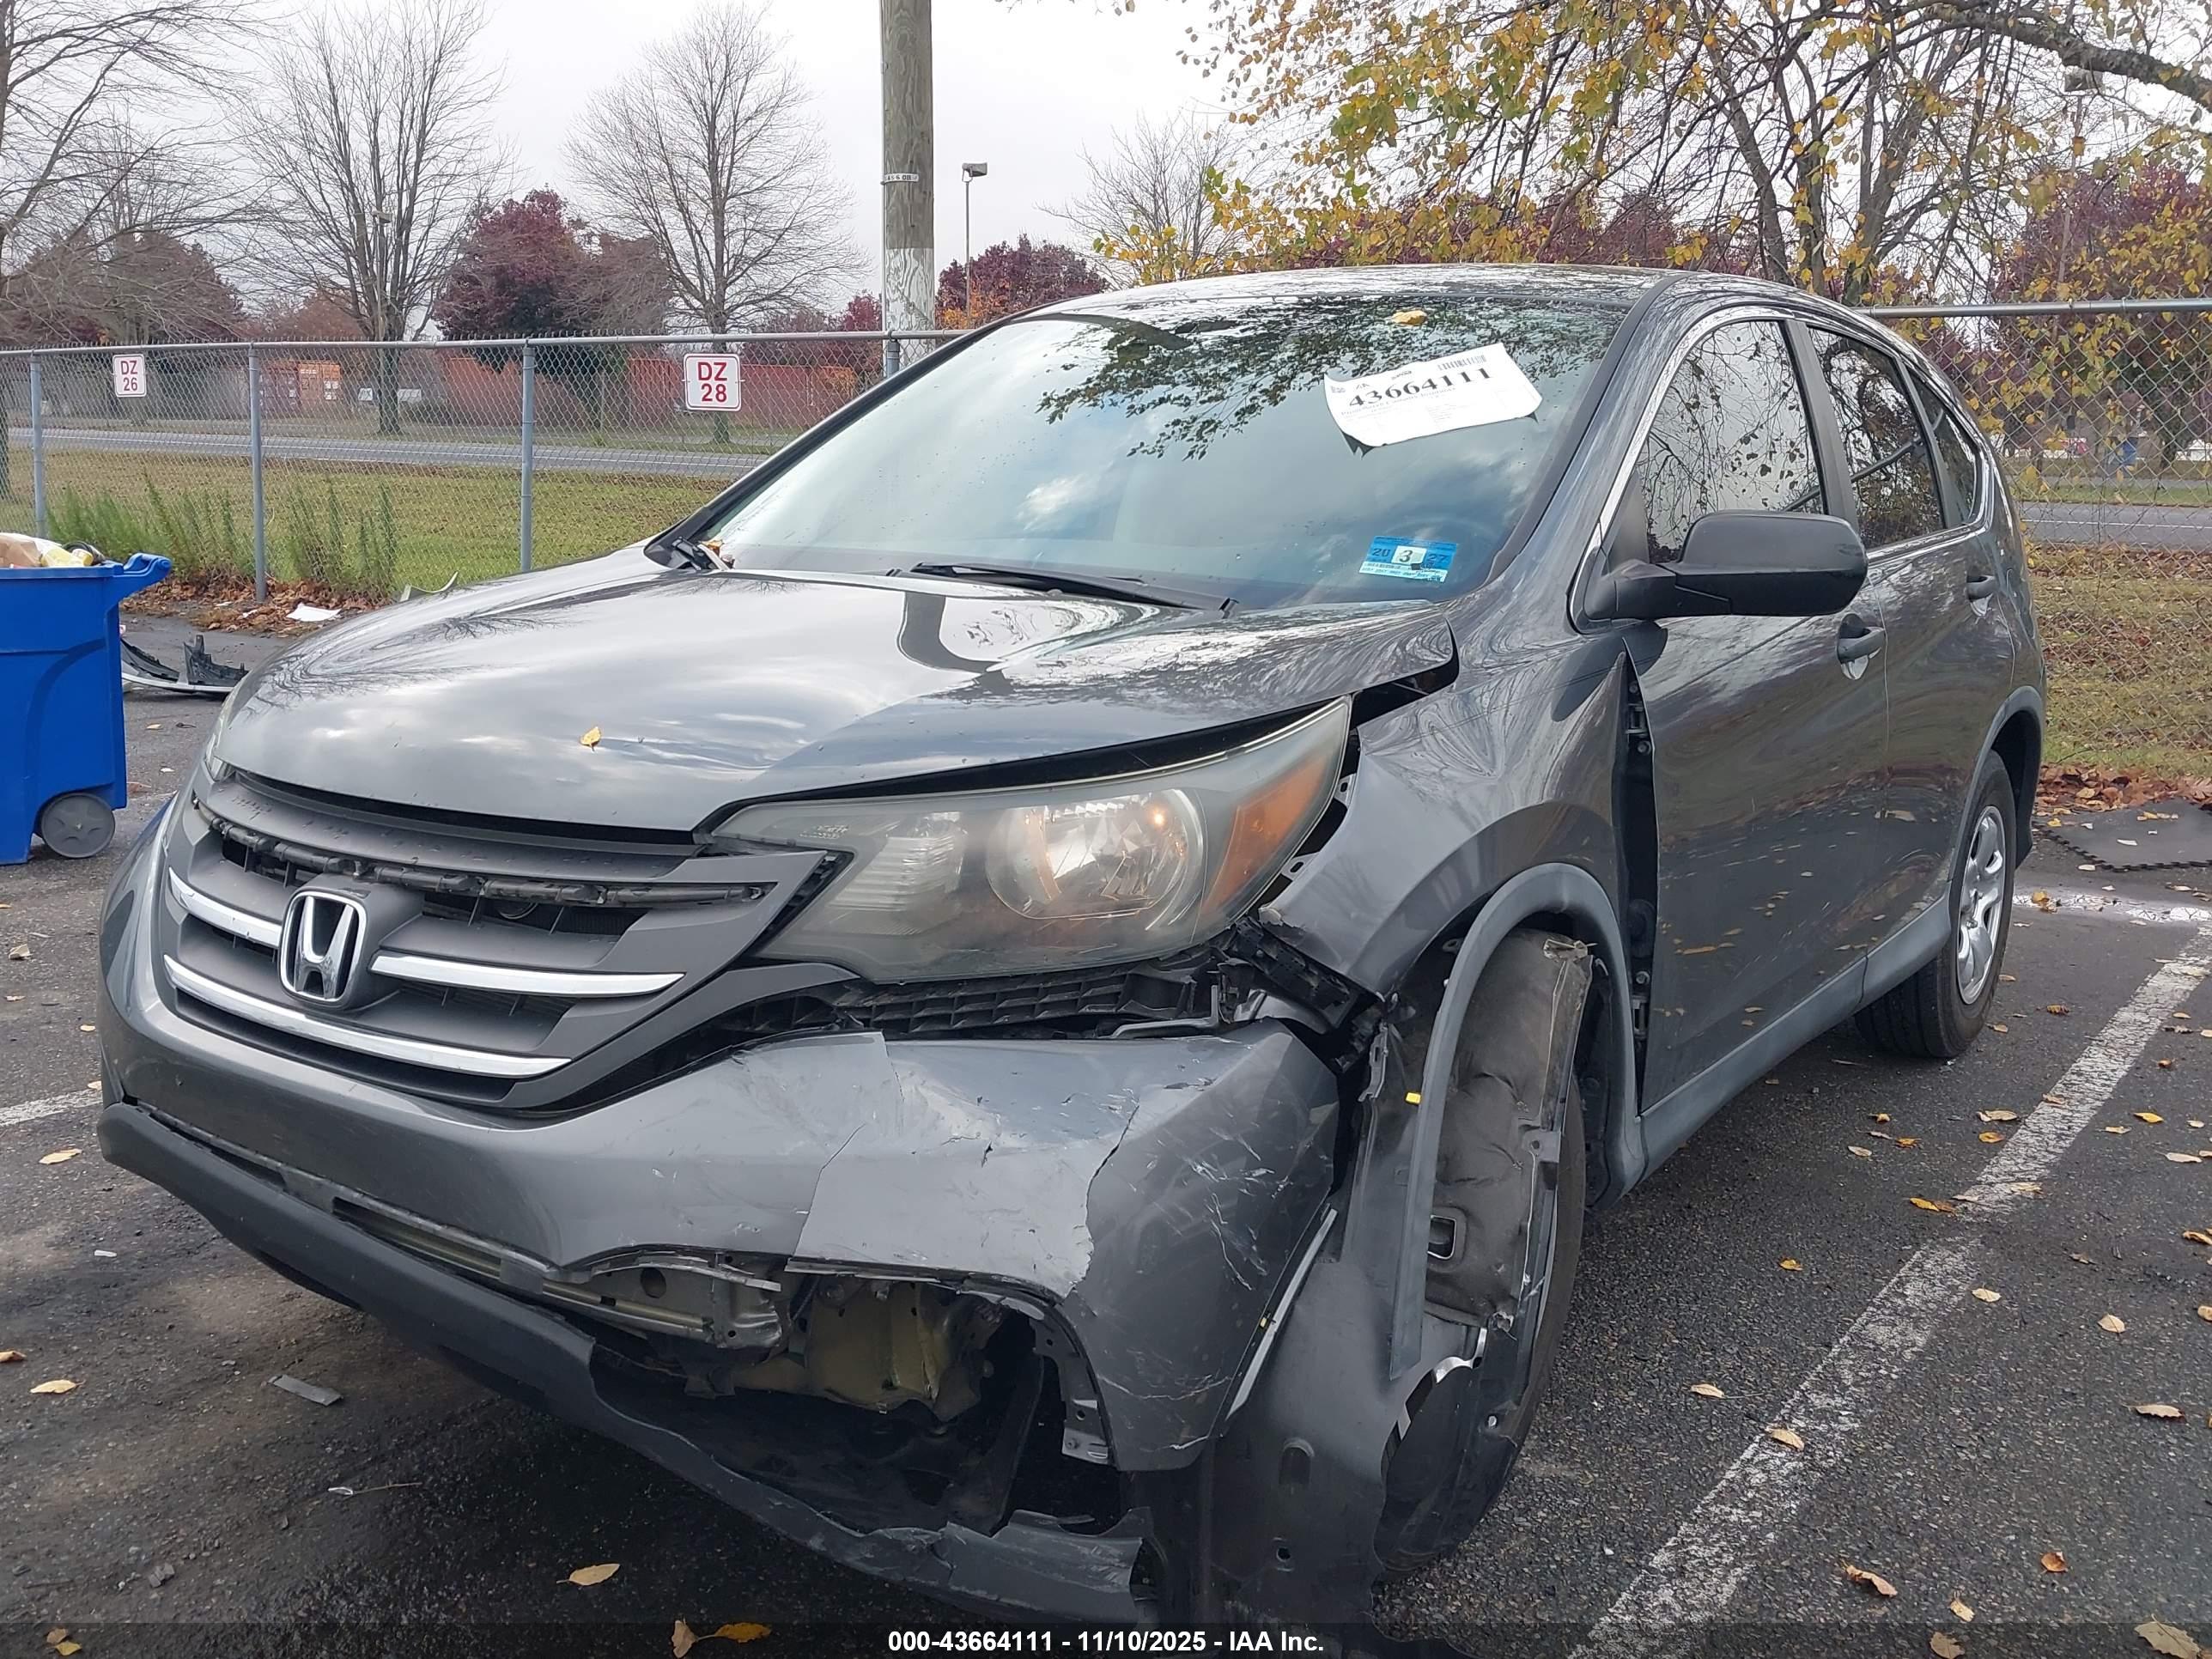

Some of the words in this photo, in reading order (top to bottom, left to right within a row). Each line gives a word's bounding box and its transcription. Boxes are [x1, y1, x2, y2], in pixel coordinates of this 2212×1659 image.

[120, 360, 138, 375] DZ
[697, 362, 728, 381] DZ
[123, 377, 138, 392] 26
[701, 383, 727, 403] 28
[1349, 368, 1493, 406] 43664111
[1372, 548, 1391, 557] 20
[1399, 550, 1413, 563] 3
